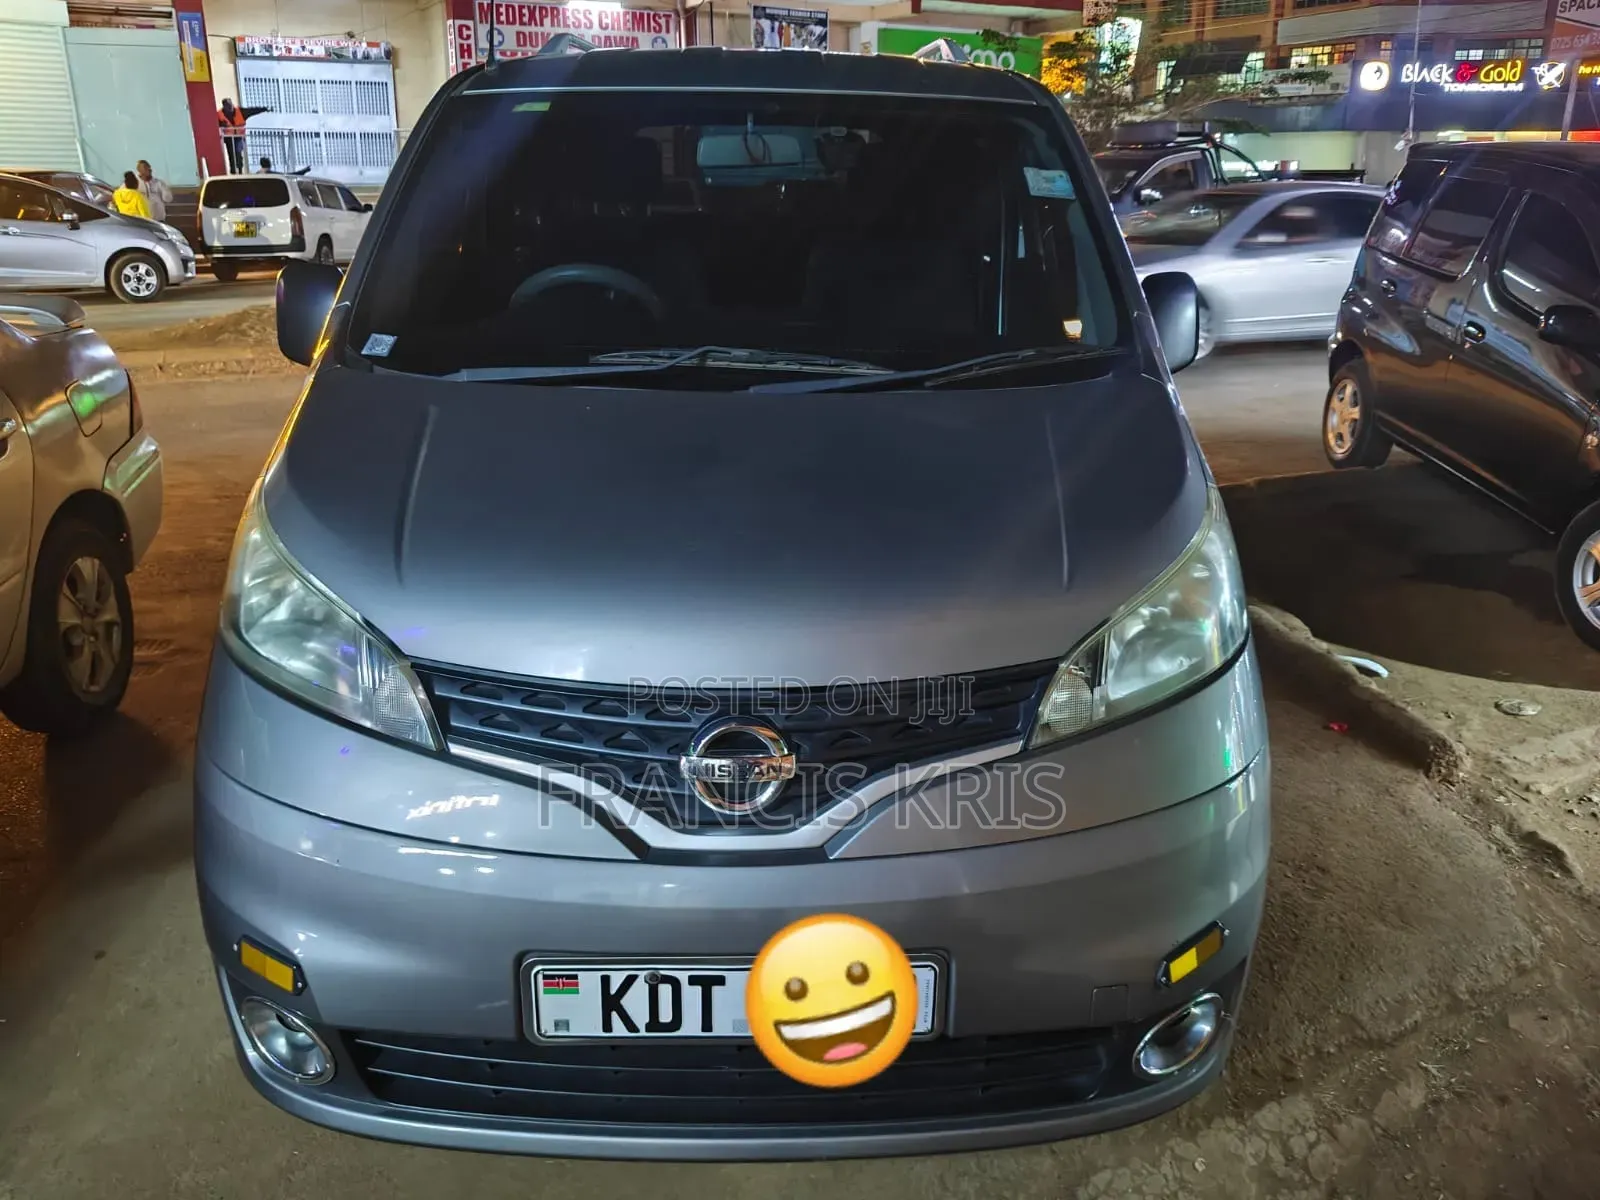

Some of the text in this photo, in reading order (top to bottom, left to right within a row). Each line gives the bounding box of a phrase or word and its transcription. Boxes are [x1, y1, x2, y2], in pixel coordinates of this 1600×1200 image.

[1558, 0, 1600, 13] SPAC
[477, 2, 673, 34] MEDEXPRESS CHEMIST
[340, 39, 367, 48] WEA
[515, 31, 551, 48] DUK
[1455, 62, 1478, 82] &
[1479, 60, 1523, 82] Gold
[690, 762, 783, 779] NISAN
[600, 974, 726, 1033] KDT
